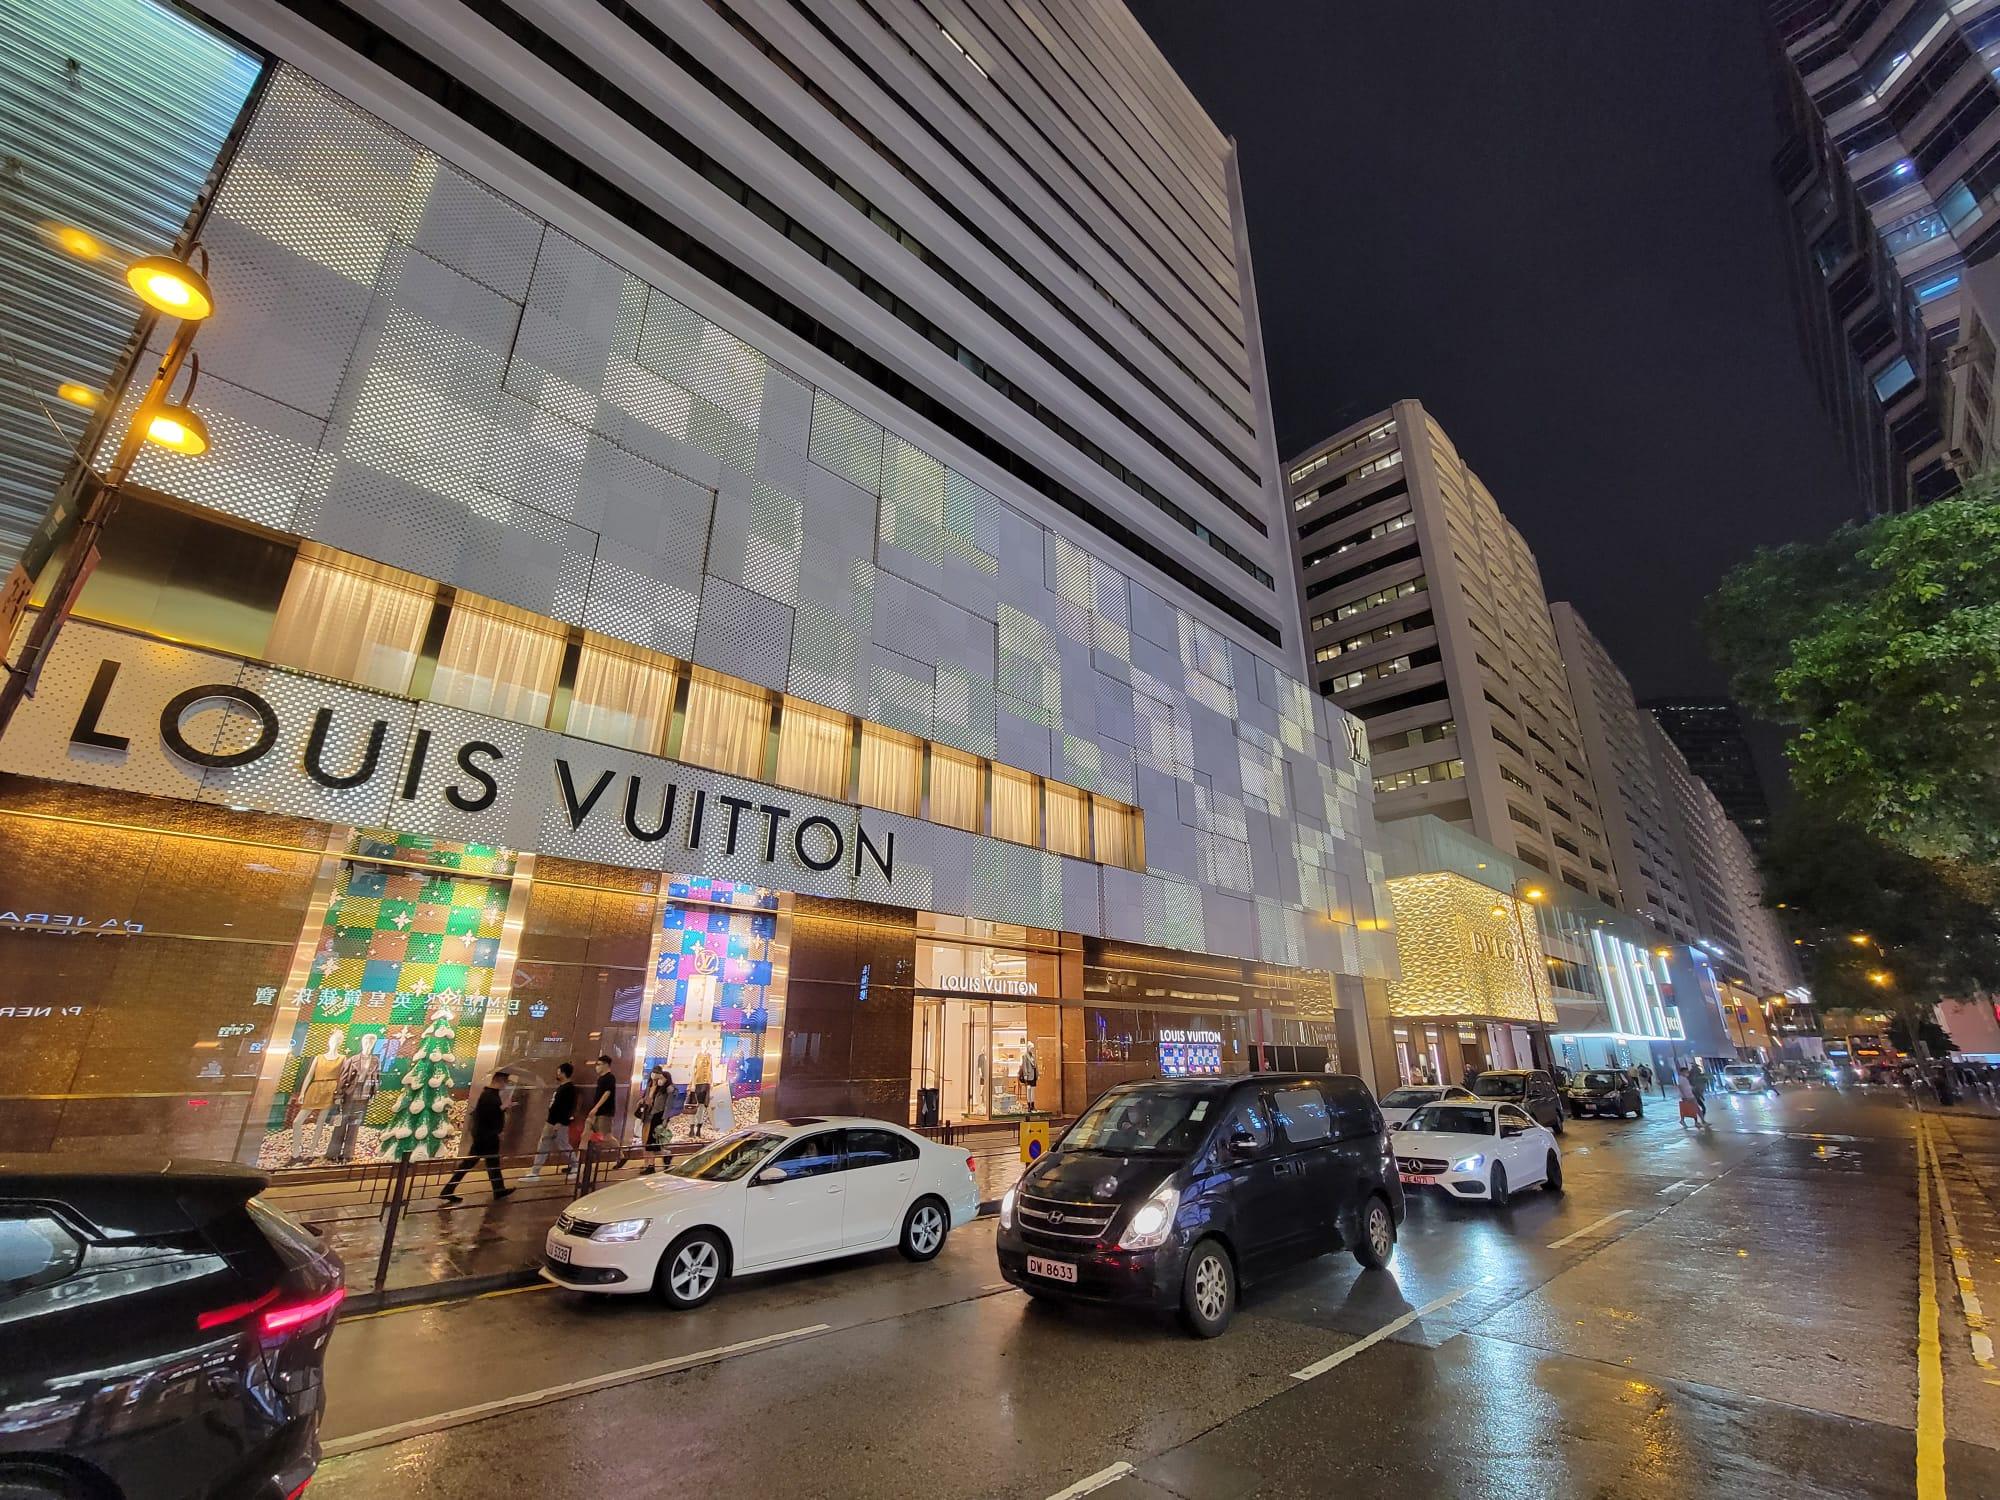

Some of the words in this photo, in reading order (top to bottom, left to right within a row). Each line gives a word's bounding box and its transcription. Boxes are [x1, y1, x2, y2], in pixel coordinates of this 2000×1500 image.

[70, 658, 504, 812] LOUIS
[554, 758, 896, 886] VUITTON
[940, 975, 981, 993] LOUIS
[983, 977, 1038, 996] VUITTON
[1160, 1029, 1186, 1042] LOUIS
[1186, 1031, 1221, 1043] VUITTON
[1030, 1259, 1043, 1274] DW
[1046, 1263, 1073, 1280] 8633
